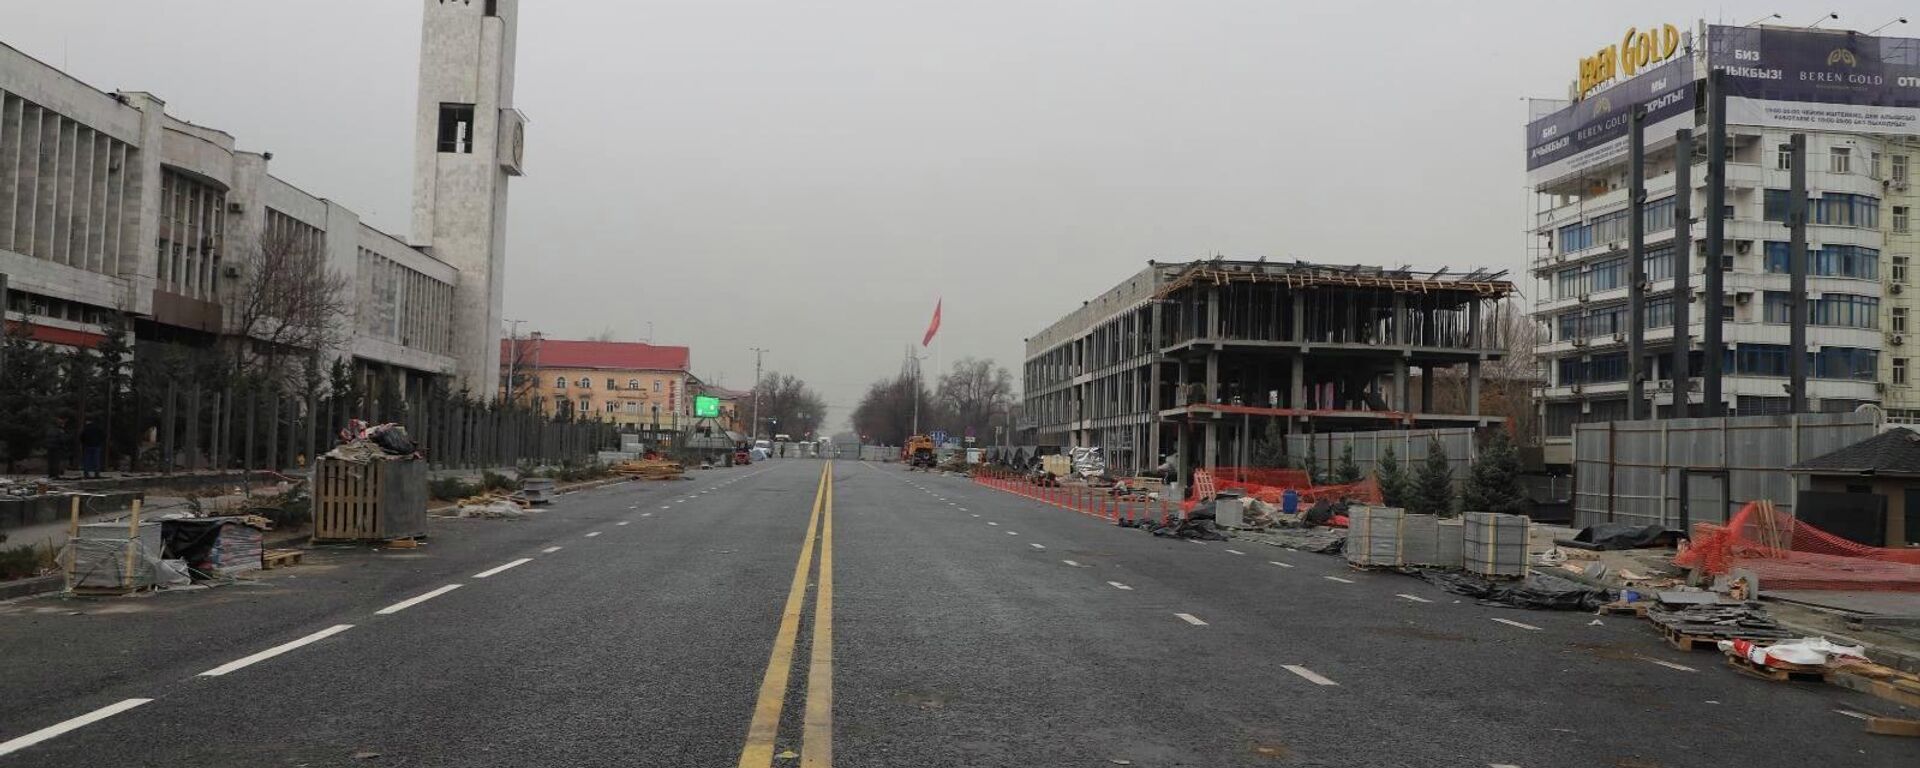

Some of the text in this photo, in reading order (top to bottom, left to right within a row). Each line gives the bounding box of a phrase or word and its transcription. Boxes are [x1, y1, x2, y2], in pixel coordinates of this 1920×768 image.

[1622, 23, 1680, 77] GOLD
[1735, 49, 1760, 61] БИЗ
[1800, 70, 1883, 86] BEREN GOLD
[1643, 88, 1684, 113] КРЫТЫ!
[1605, 113, 1627, 130] GOLD
